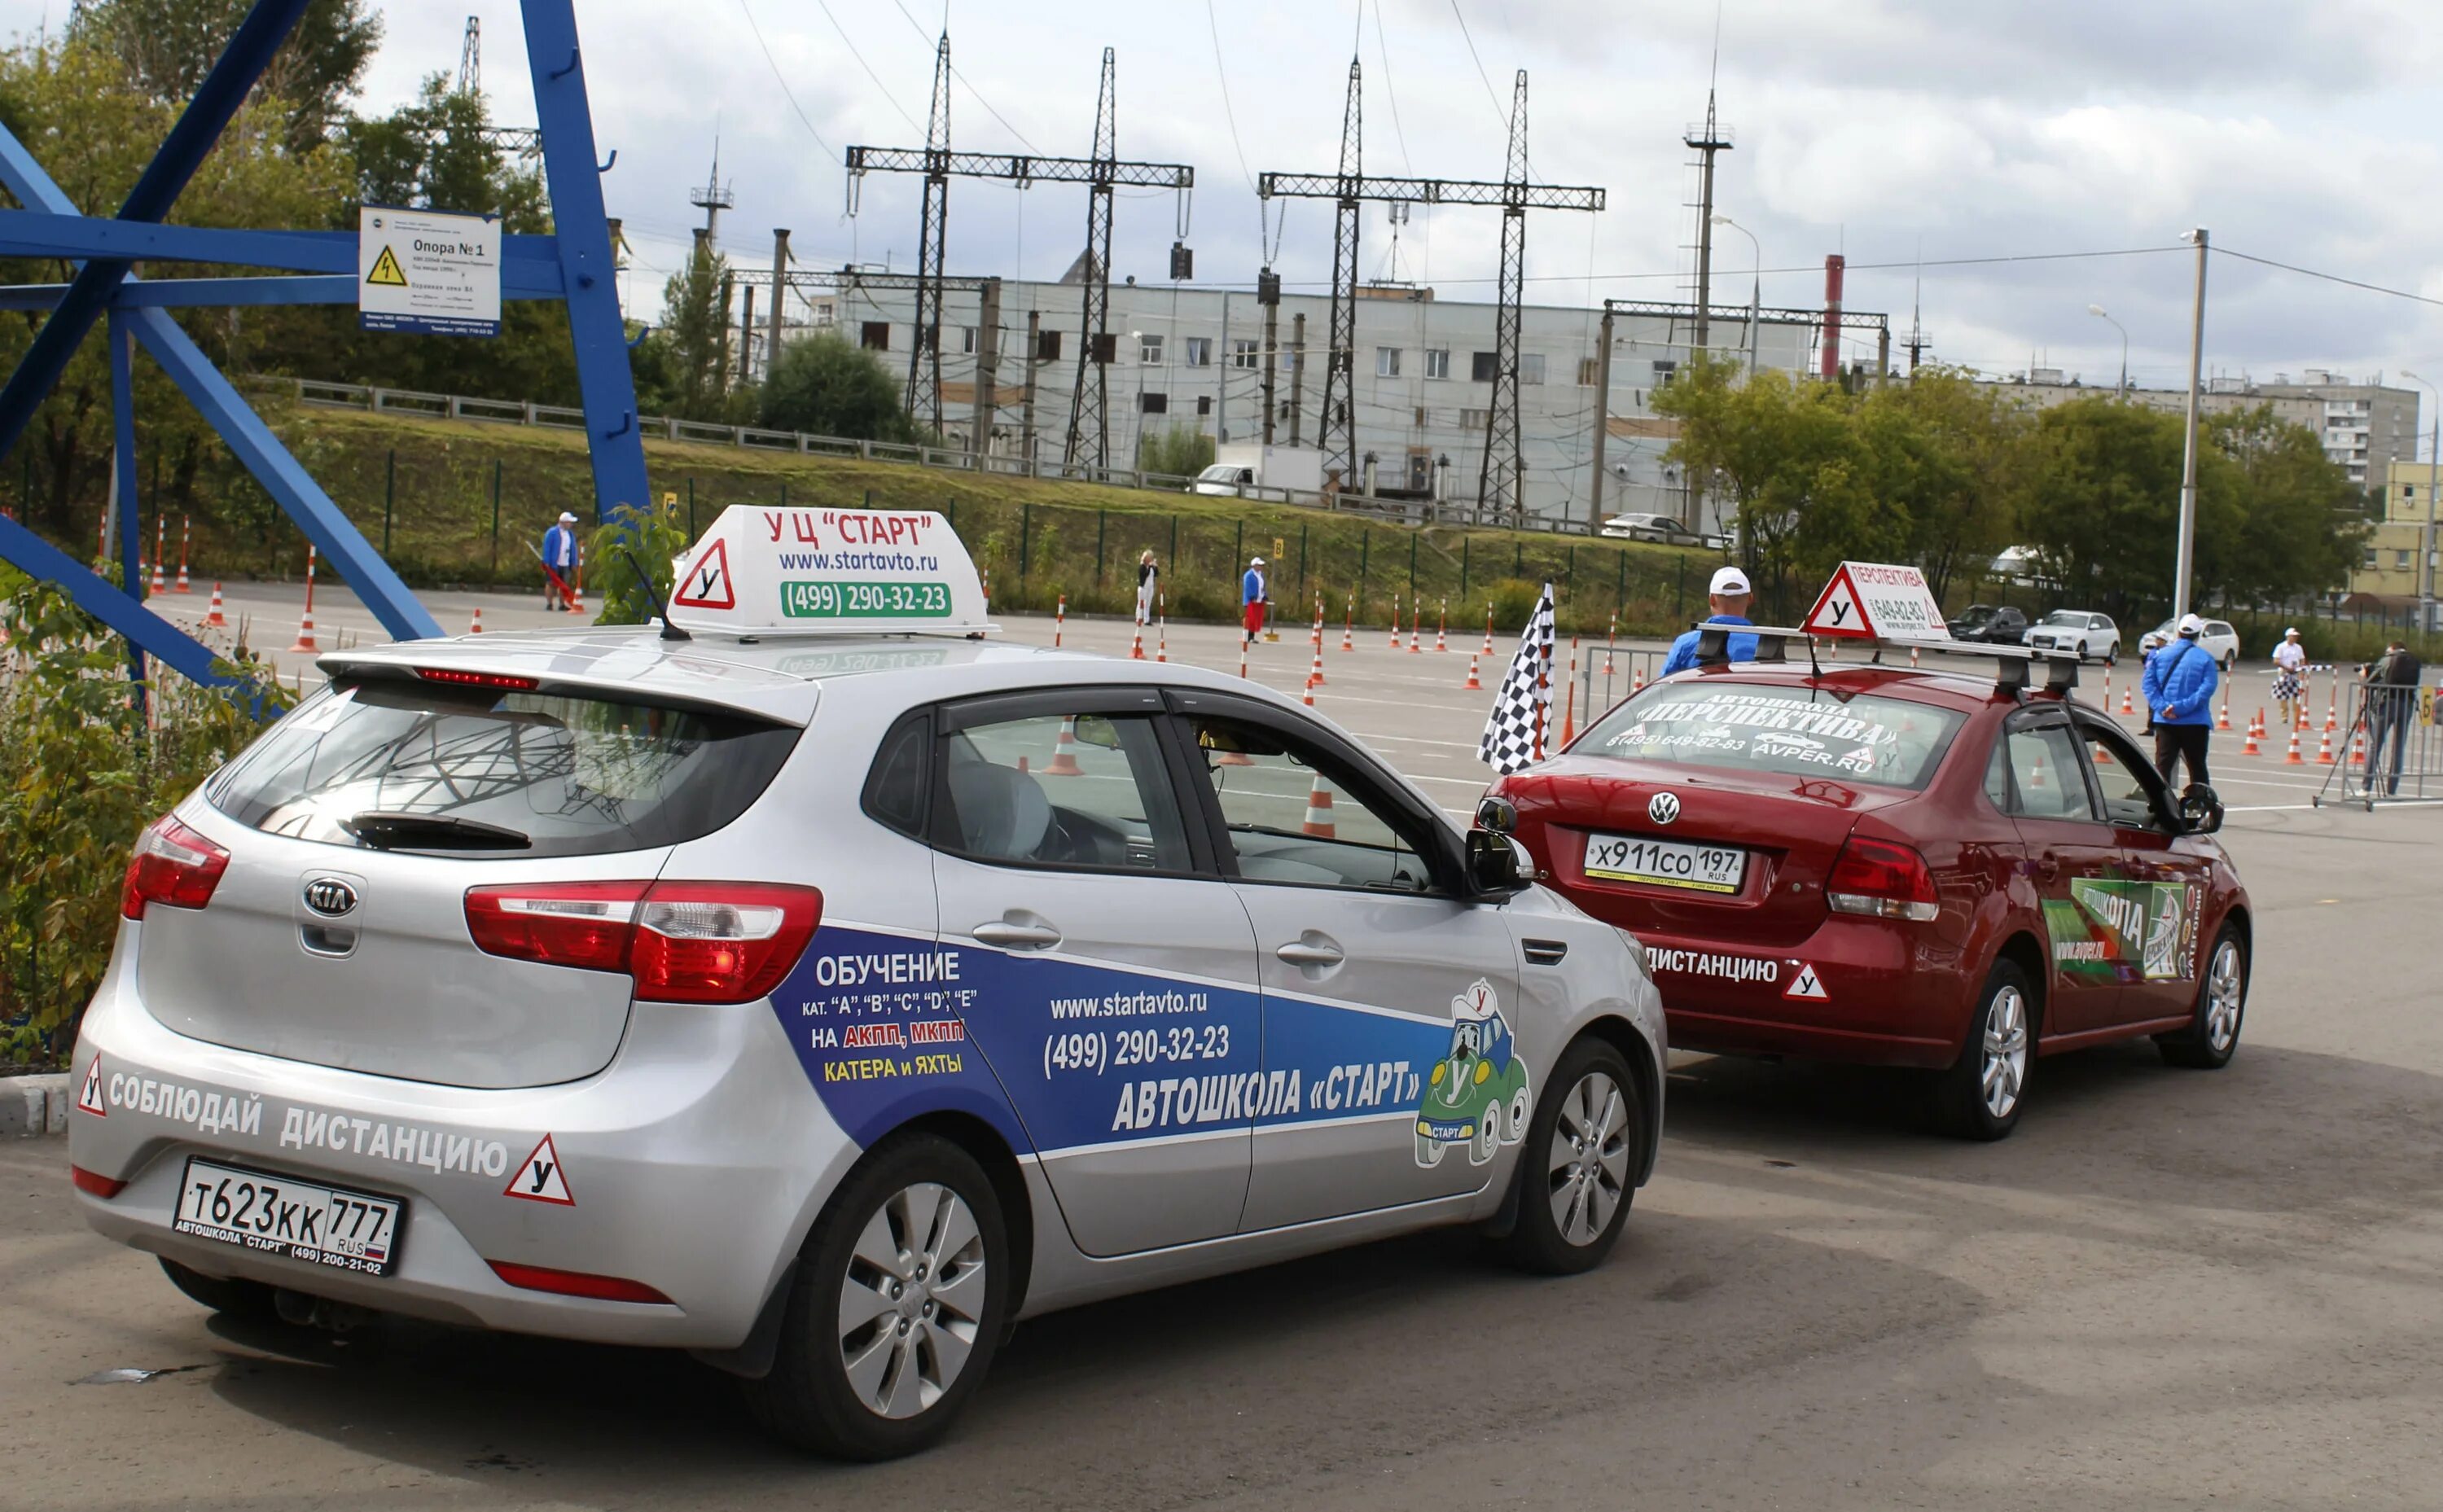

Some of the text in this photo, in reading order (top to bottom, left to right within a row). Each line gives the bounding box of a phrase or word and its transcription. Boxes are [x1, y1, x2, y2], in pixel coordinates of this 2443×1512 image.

[414, 239, 455, 256] Опора
[823, 512, 932, 546] “СТАРТ”
[779, 550, 938, 571] www.startavto.ru
[1850, 566, 1925, 586] ПЕРСПЕКТИВА
[787, 583, 946, 616] (499) 290-32-23
[1875, 599, 1926, 620] 649-82-83
[1704, 695, 1851, 717] АВТОШКОЛА
[1637, 703, 1897, 745] «ПЕРСПЕКТИВА»
[1661, 735, 1746, 751] 649-82-83
[1752, 743, 1872, 774] AVPER.RU
[1700, 848, 1737, 873] 197
[1708, 872, 1727, 882] RUS
[310, 885, 347, 910] KIA
[1645, 947, 1778, 983] ДИСТАНЦИЮ
[2056, 941, 2106, 964] www.avper.ru
[816, 952, 960, 986] ОБУЧЕНИЕ
[802, 1001, 827, 1016] КАТ.
[1050, 989, 1207, 1019] www.startavto.ru
[812, 1019, 965, 1050] НА АКПП, МКПП
[1044, 1024, 1230, 1080] (499) 290-32-23
[824, 1054, 963, 1082] КАТЕРА и ЯХТЫ
[1112, 1061, 1420, 1131] АВТОШКОЛА «СТАРТ»
[109, 1072, 508, 1177] СОБЛЮДАЙ ДИСТАНЦИЮ
[1432, 1127, 1459, 1138] СТАРТ
[331, 1198, 388, 1242] 777
[175, 1220, 241, 1244] АВТОШКОЛА
[291, 1245, 321, 1263] (499)
[322, 1252, 382, 1275] 200-21-02
[337, 1238, 366, 1255] RUS
